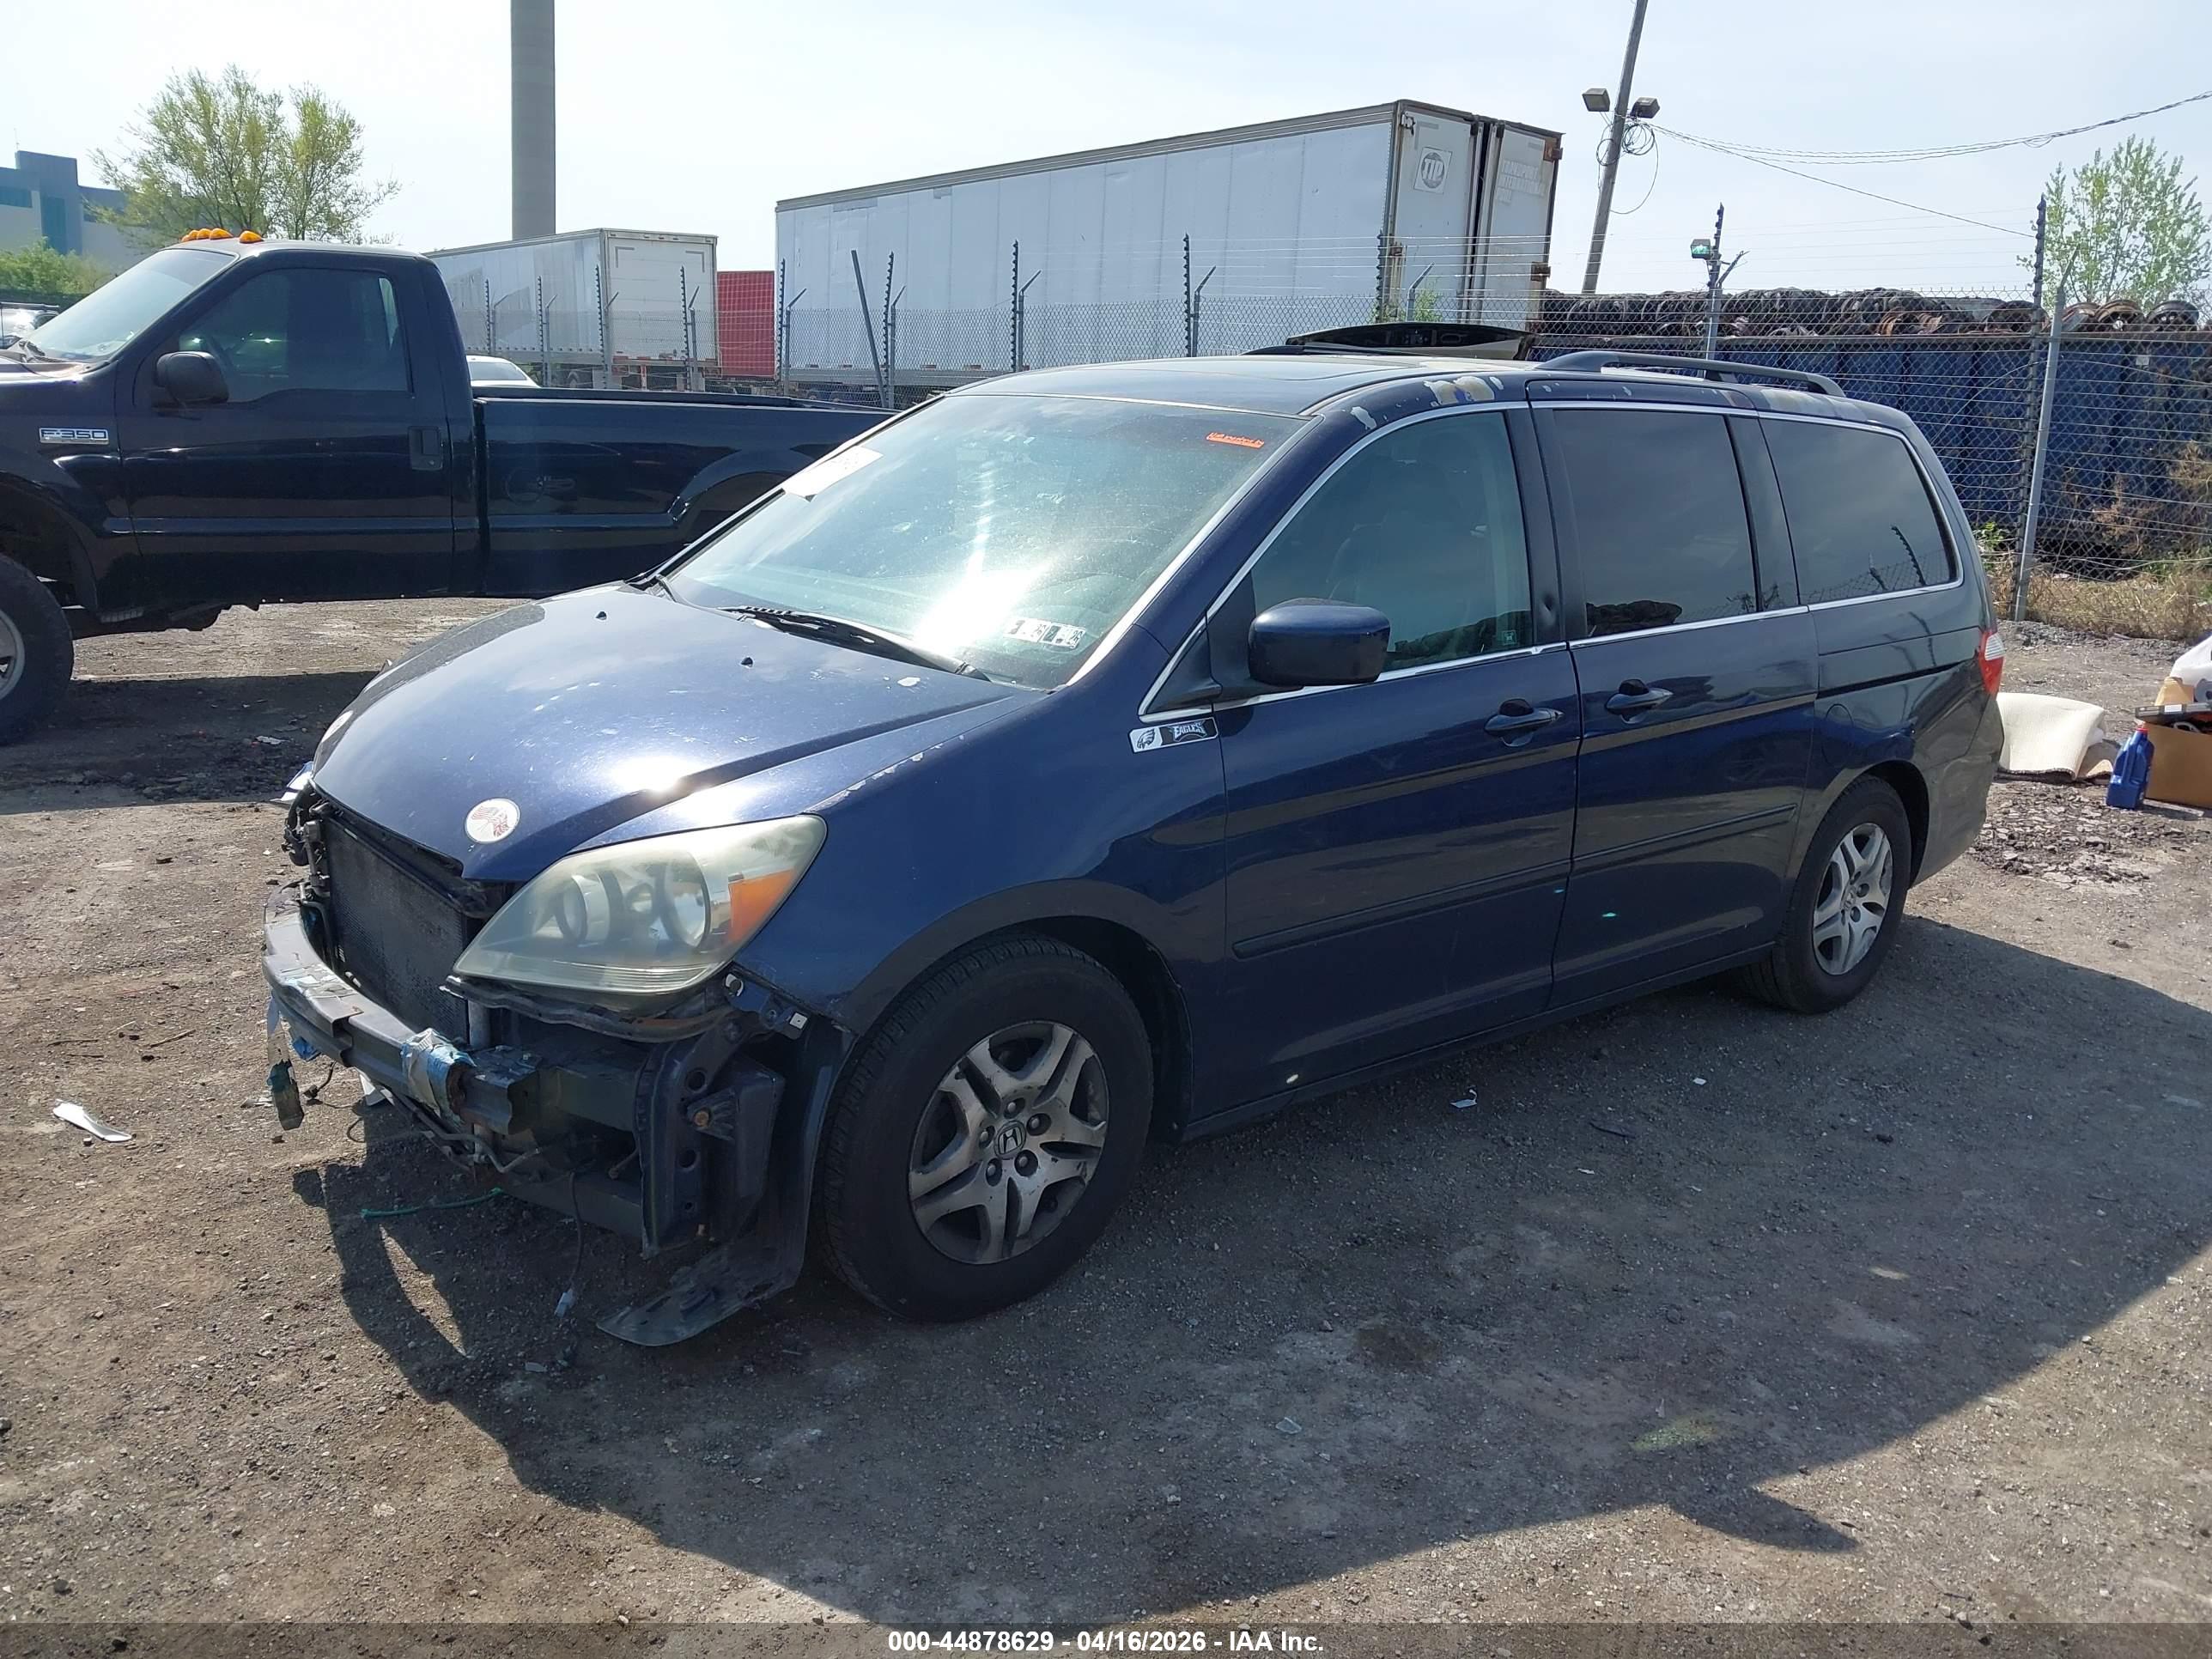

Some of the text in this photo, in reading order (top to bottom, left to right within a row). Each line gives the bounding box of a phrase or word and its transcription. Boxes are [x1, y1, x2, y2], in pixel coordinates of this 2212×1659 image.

[1422, 158, 1443, 181] TIP
[40, 429, 106, 440] F-350
[1173, 720, 1206, 739] EAGLES
